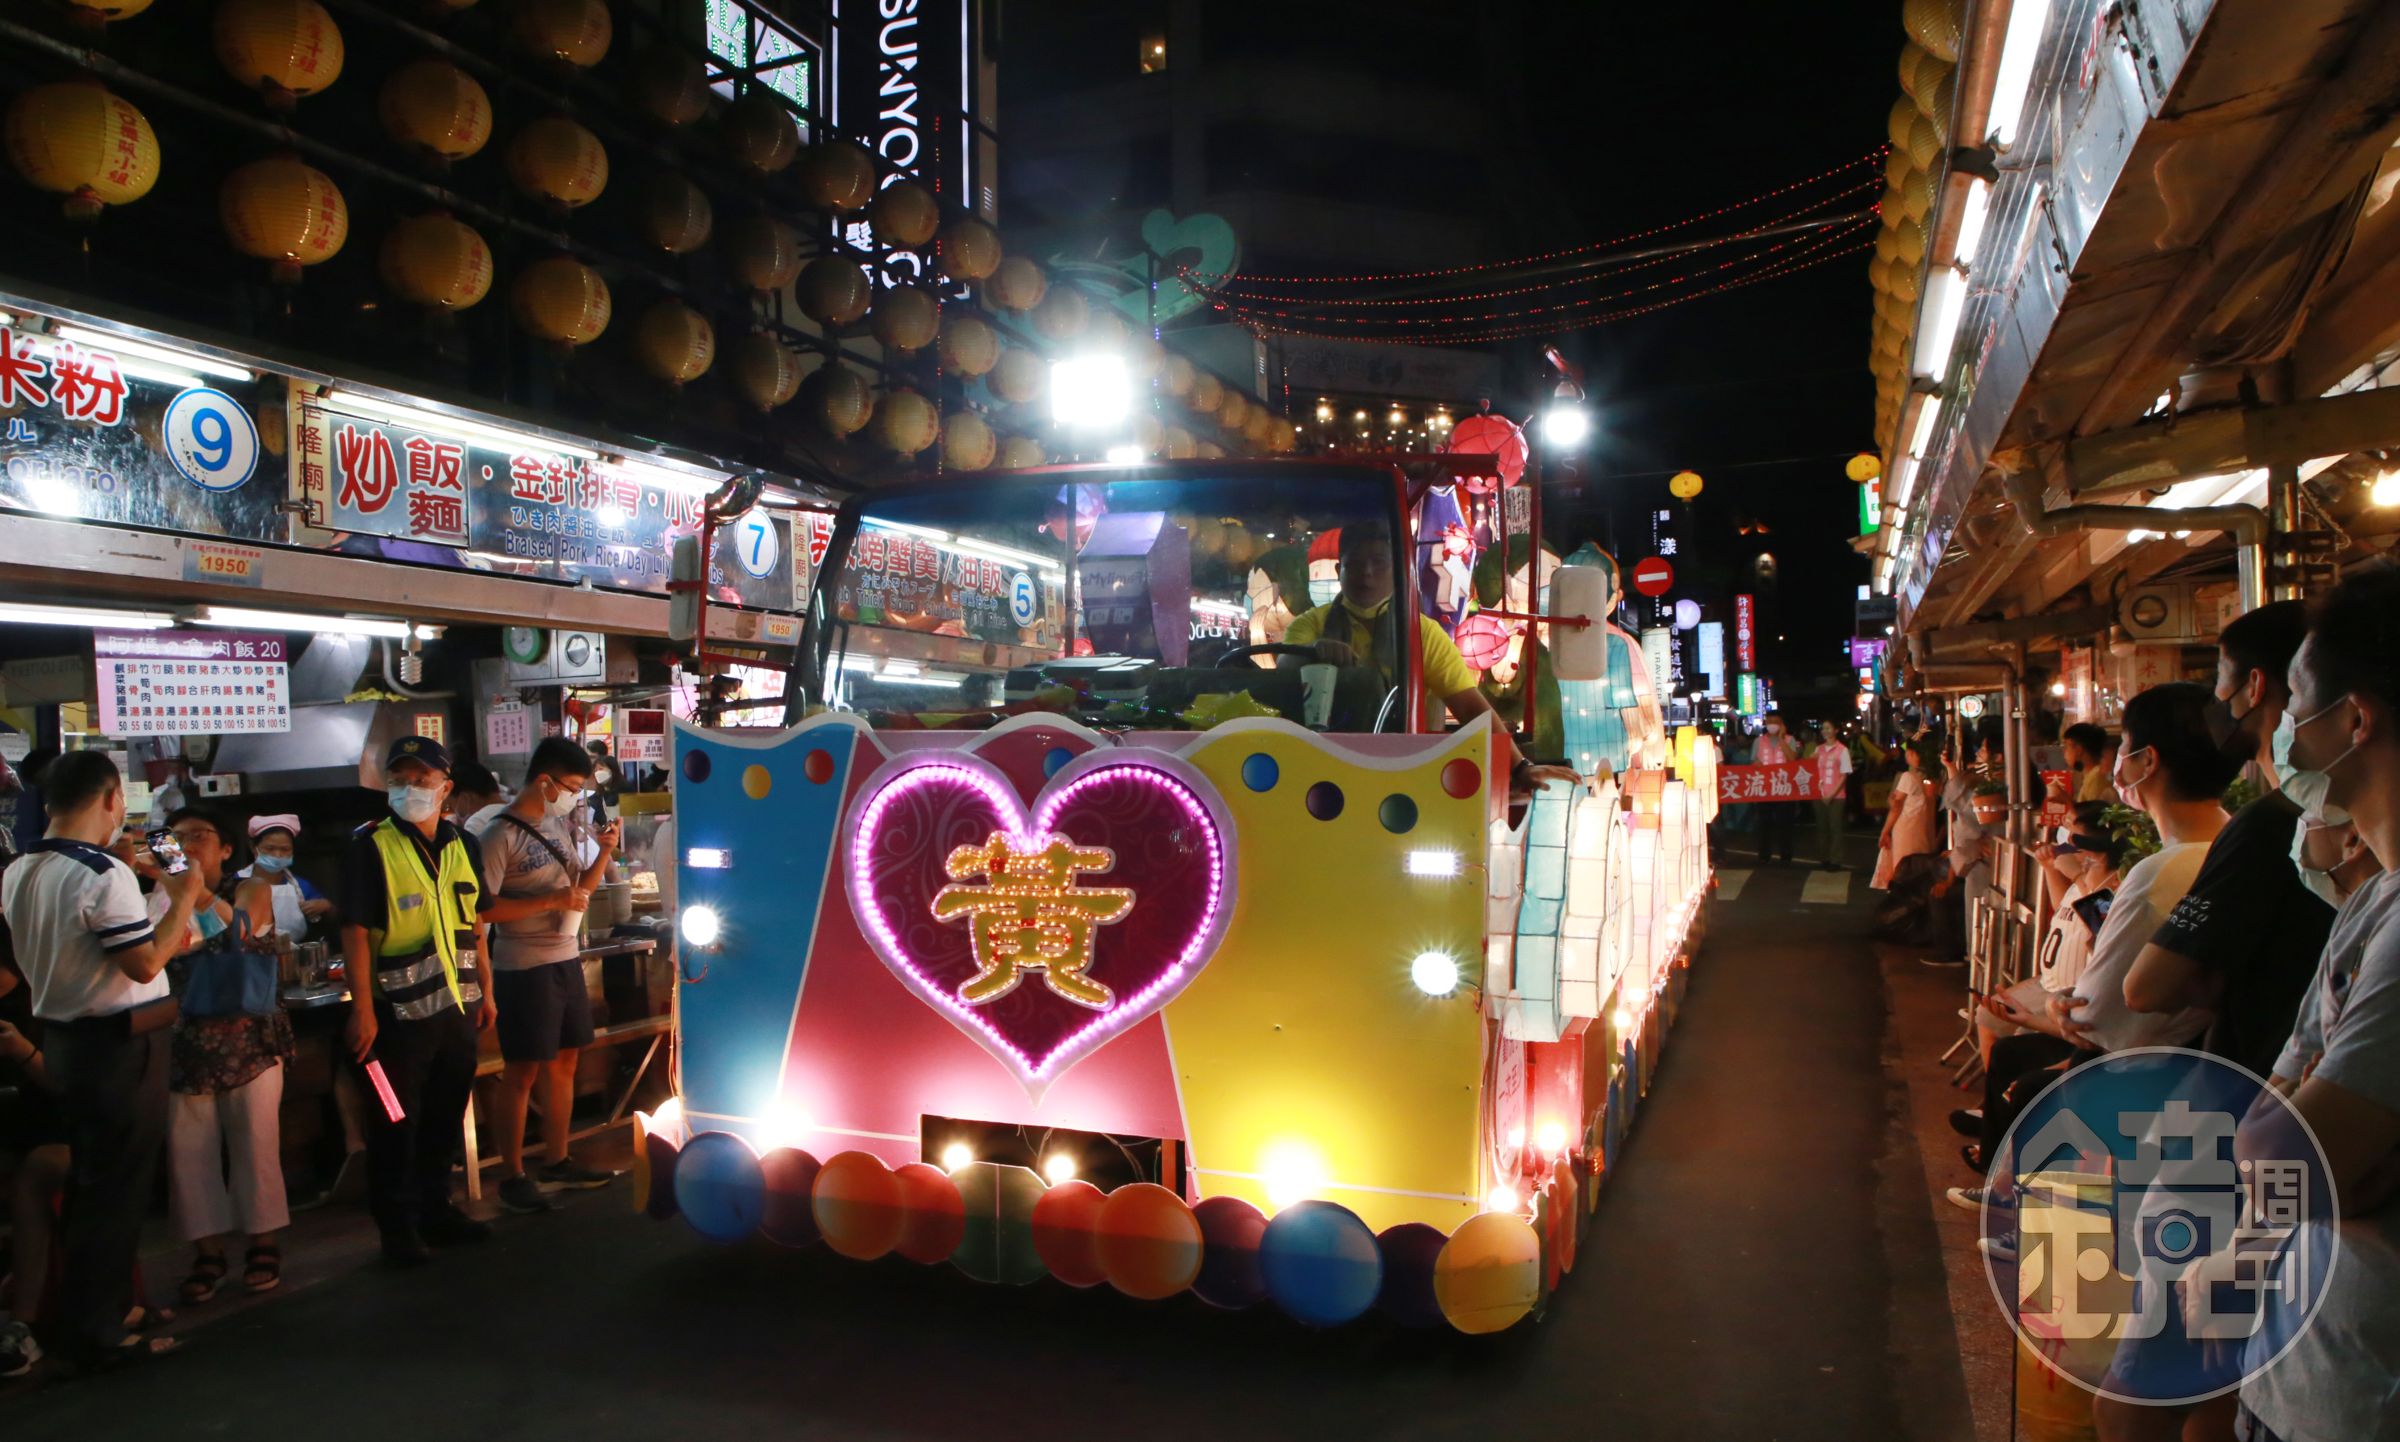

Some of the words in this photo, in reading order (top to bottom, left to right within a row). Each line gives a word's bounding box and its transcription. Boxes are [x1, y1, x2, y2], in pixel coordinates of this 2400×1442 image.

[191, 407, 232, 472] 9
[297, 388, 324, 526] 基隆廟口
[506, 529, 554, 558] Braised
[560, 538, 588, 564] Pork
[596, 545, 647, 577] Rice/Day
[653, 555, 673, 580] Lily
[748, 523, 765, 566] 7
[205, 556, 246, 574] 1950
[1015, 584, 1033, 618] 5
[771, 623, 790, 635] 1950
[260, 641, 280, 658] 20
[1720, 765, 1813, 799] 交流協會
